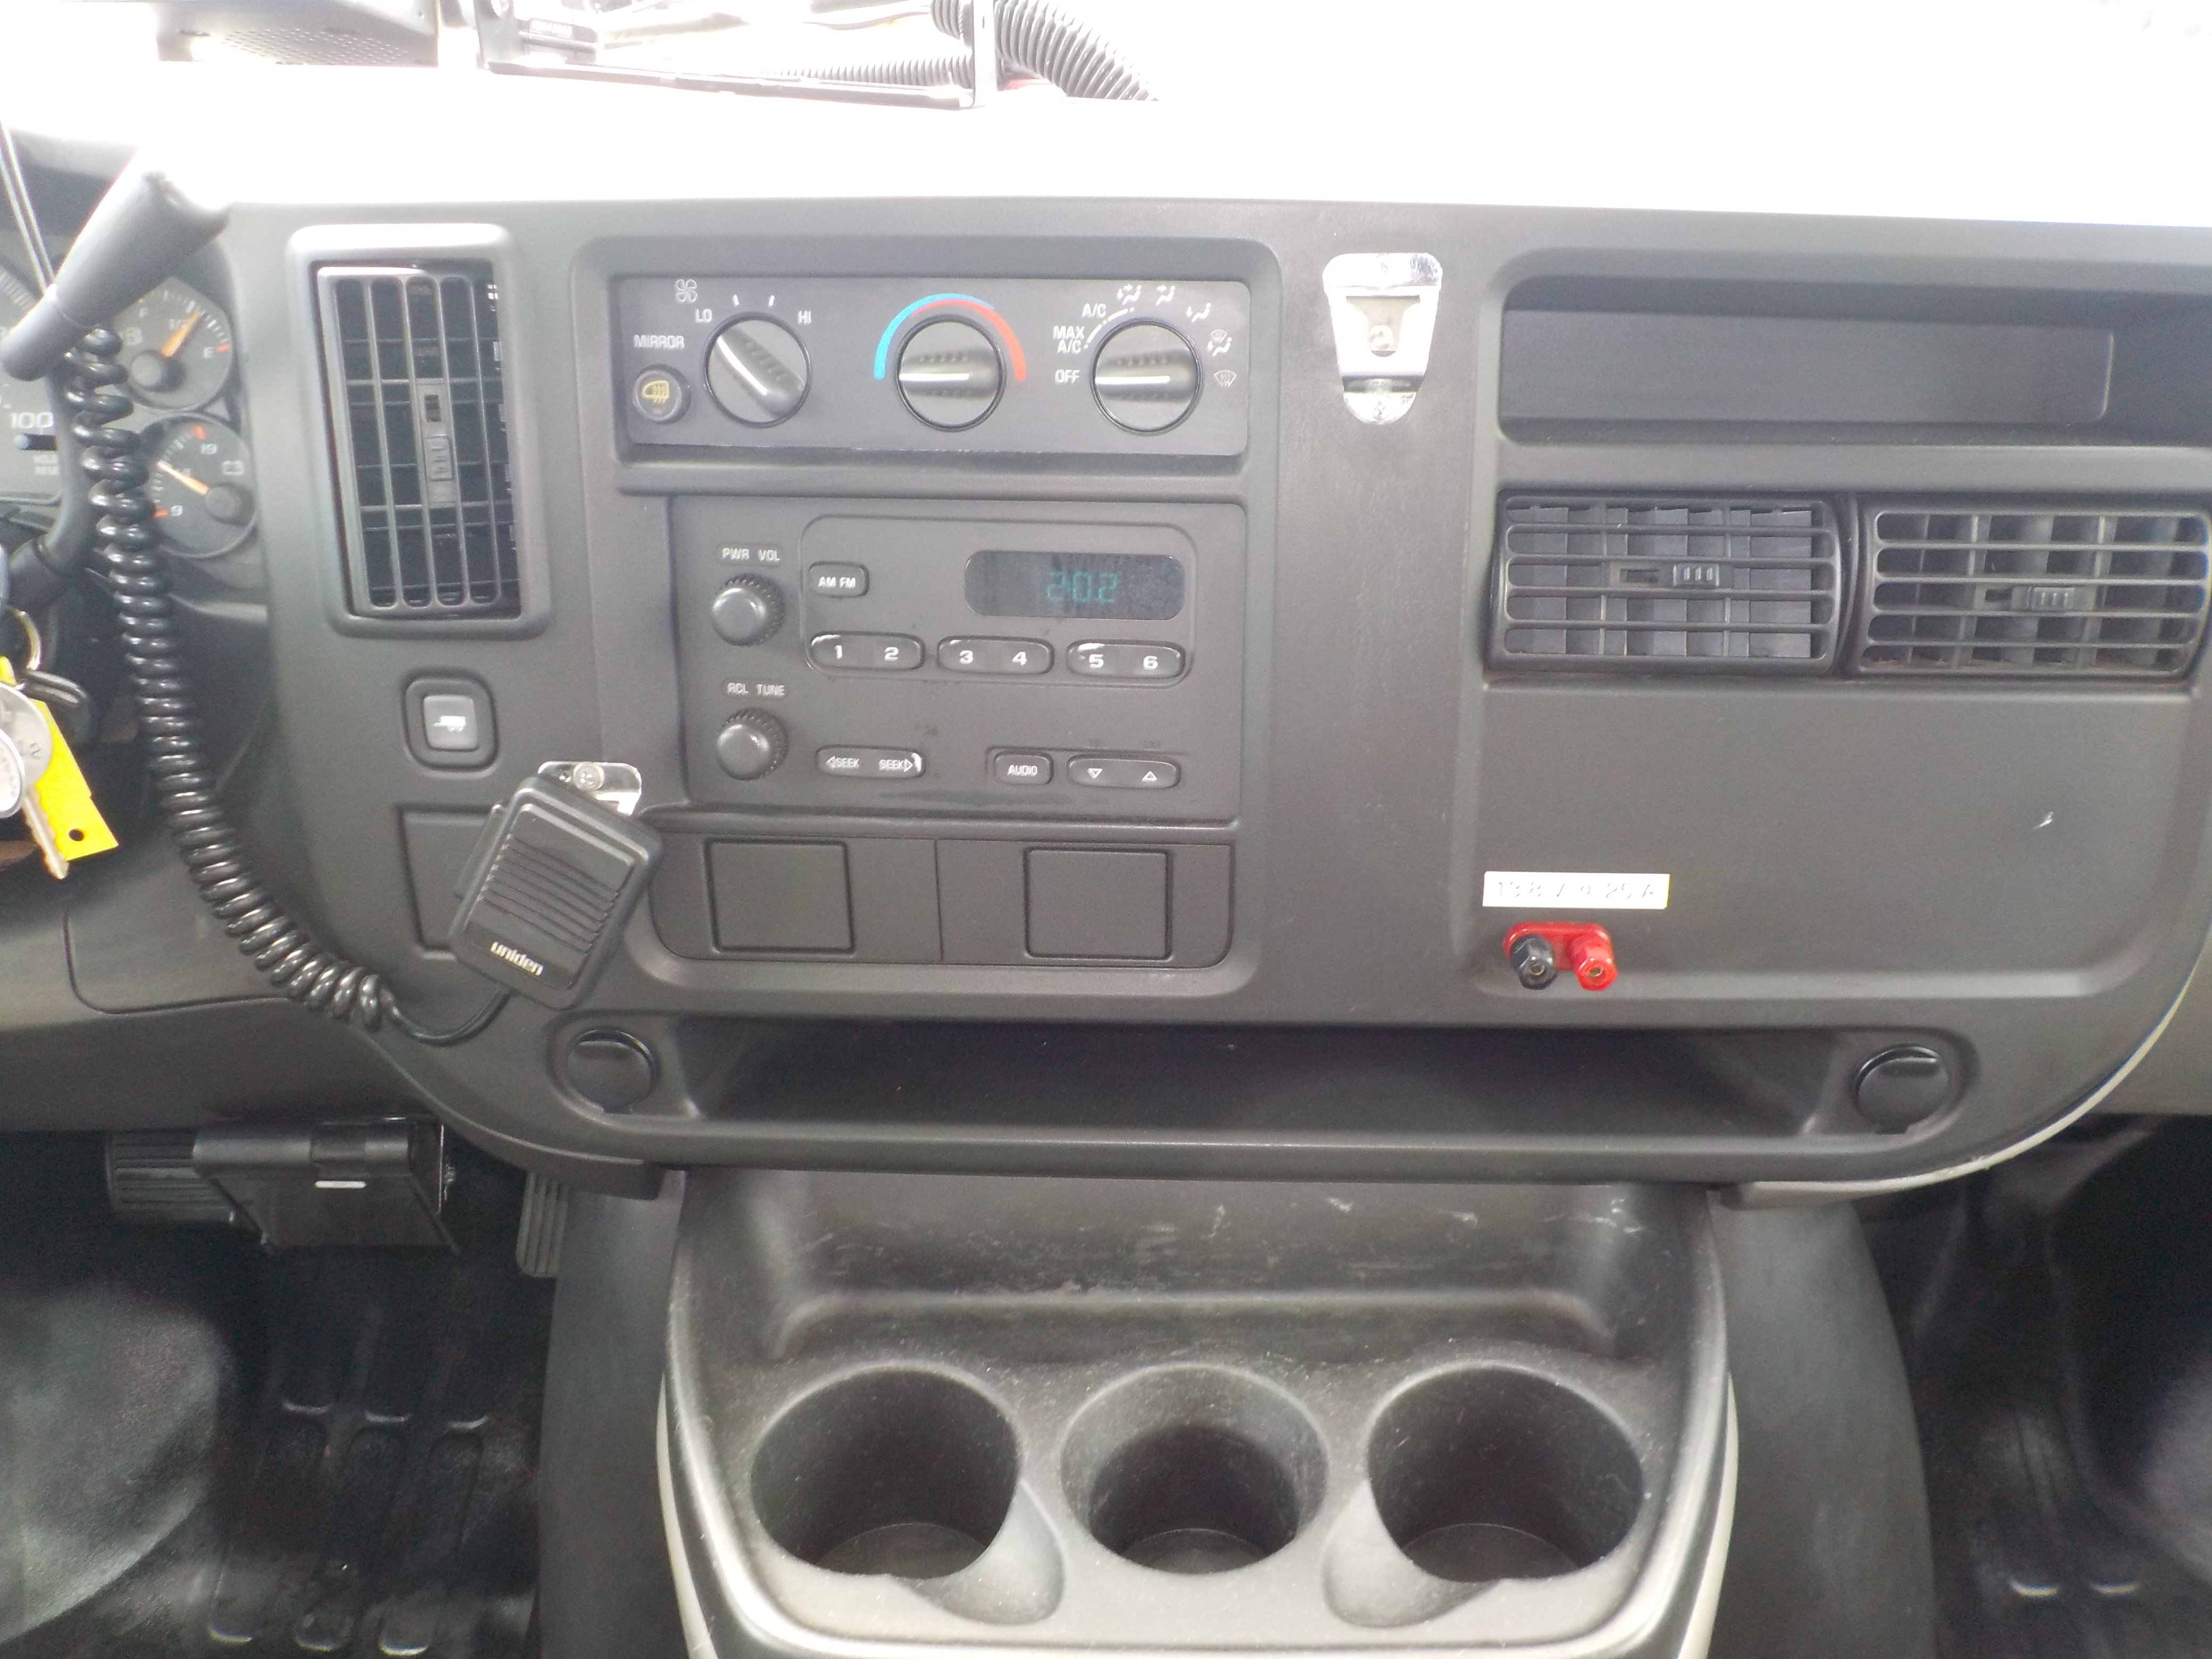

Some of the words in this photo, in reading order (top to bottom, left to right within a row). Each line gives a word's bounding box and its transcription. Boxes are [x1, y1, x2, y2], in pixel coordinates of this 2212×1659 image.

[695, 308, 713, 323] LO
[798, 311, 812, 324] HI
[1082, 303, 1107, 318] A/C
[1052, 325, 1085, 339] MAX
[633, 334, 685, 350] MIRROR
[1057, 339, 1082, 353] A/C
[203, 346, 215, 359] E
[1054, 369, 1080, 383] OFF
[722, 547, 750, 560] PWR
[758, 549, 781, 562] VOL
[818, 576, 836, 588] AM
[839, 576, 856, 589] FM
[834, 644, 843, 659] 1
[883, 647, 899, 661] 2
[959, 650, 974, 665] 3
[1012, 650, 1028, 666] 4
[1088, 653, 1104, 669] 5
[1142, 655, 1159, 671] 6
[727, 682, 749, 694] RCL
[756, 683, 785, 697] TUNE
[835, 757, 860, 768] SEEK
[879, 759, 904, 771] SEEK
[1007, 764, 1039, 776] AUDIO
[489, 941, 545, 977] uniden
